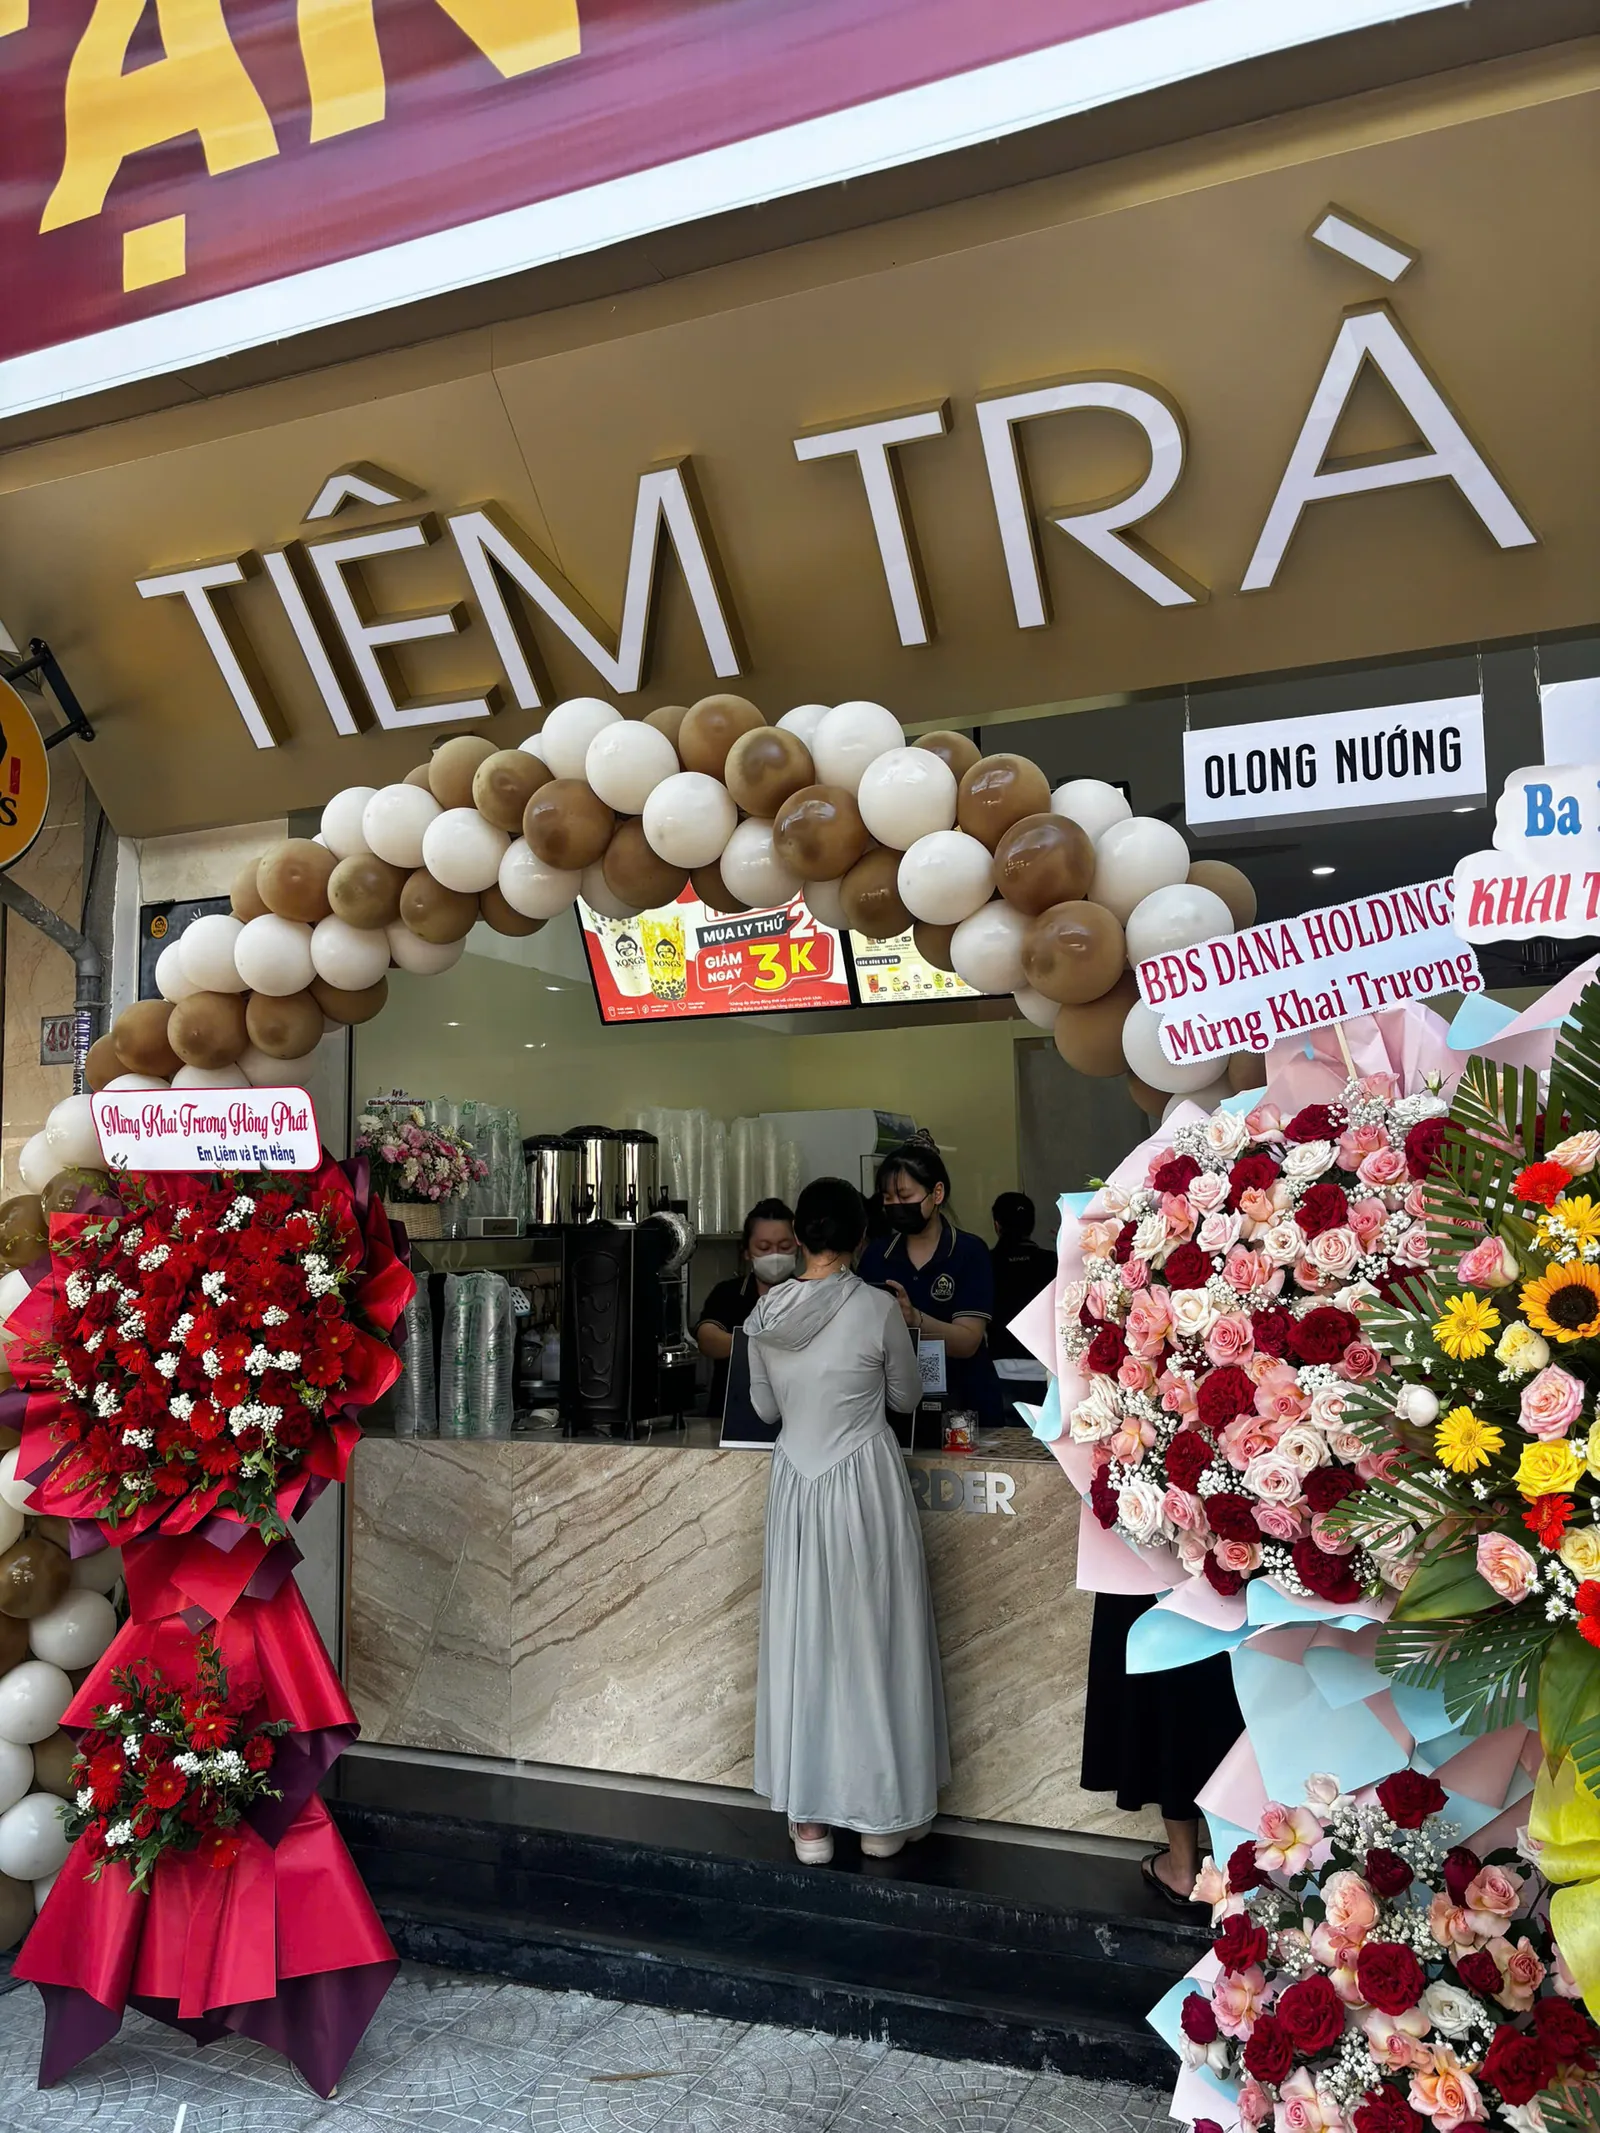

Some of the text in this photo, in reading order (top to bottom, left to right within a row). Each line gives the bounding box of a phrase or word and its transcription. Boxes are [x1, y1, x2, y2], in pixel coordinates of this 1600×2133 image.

[136, 213, 1539, 749] TIÊM TRÀ
[1205, 724, 1462, 799] OLONG NƯỚNG
[1523, 783, 1582, 837] Ba
[1468, 873, 1571, 927] KHAI
[703, 927, 735, 943] MUA
[737, 923, 753, 937] LY
[755, 915, 785, 934] THỨ
[705, 950, 742, 969] GIẢM
[708, 968, 742, 983] NGAY
[1140, 948, 1208, 1006] BĐS
[1209, 923, 1301, 986] DANA
[1165, 953, 1480, 1061] Mừng Khai Trương
[142, 1104, 178, 1137] Khai
[228, 1102, 268, 1139] Hồng
[271, 1101, 308, 1135] Phát
[197, 1142, 296, 1164] Em Liêm và Em Hằng
